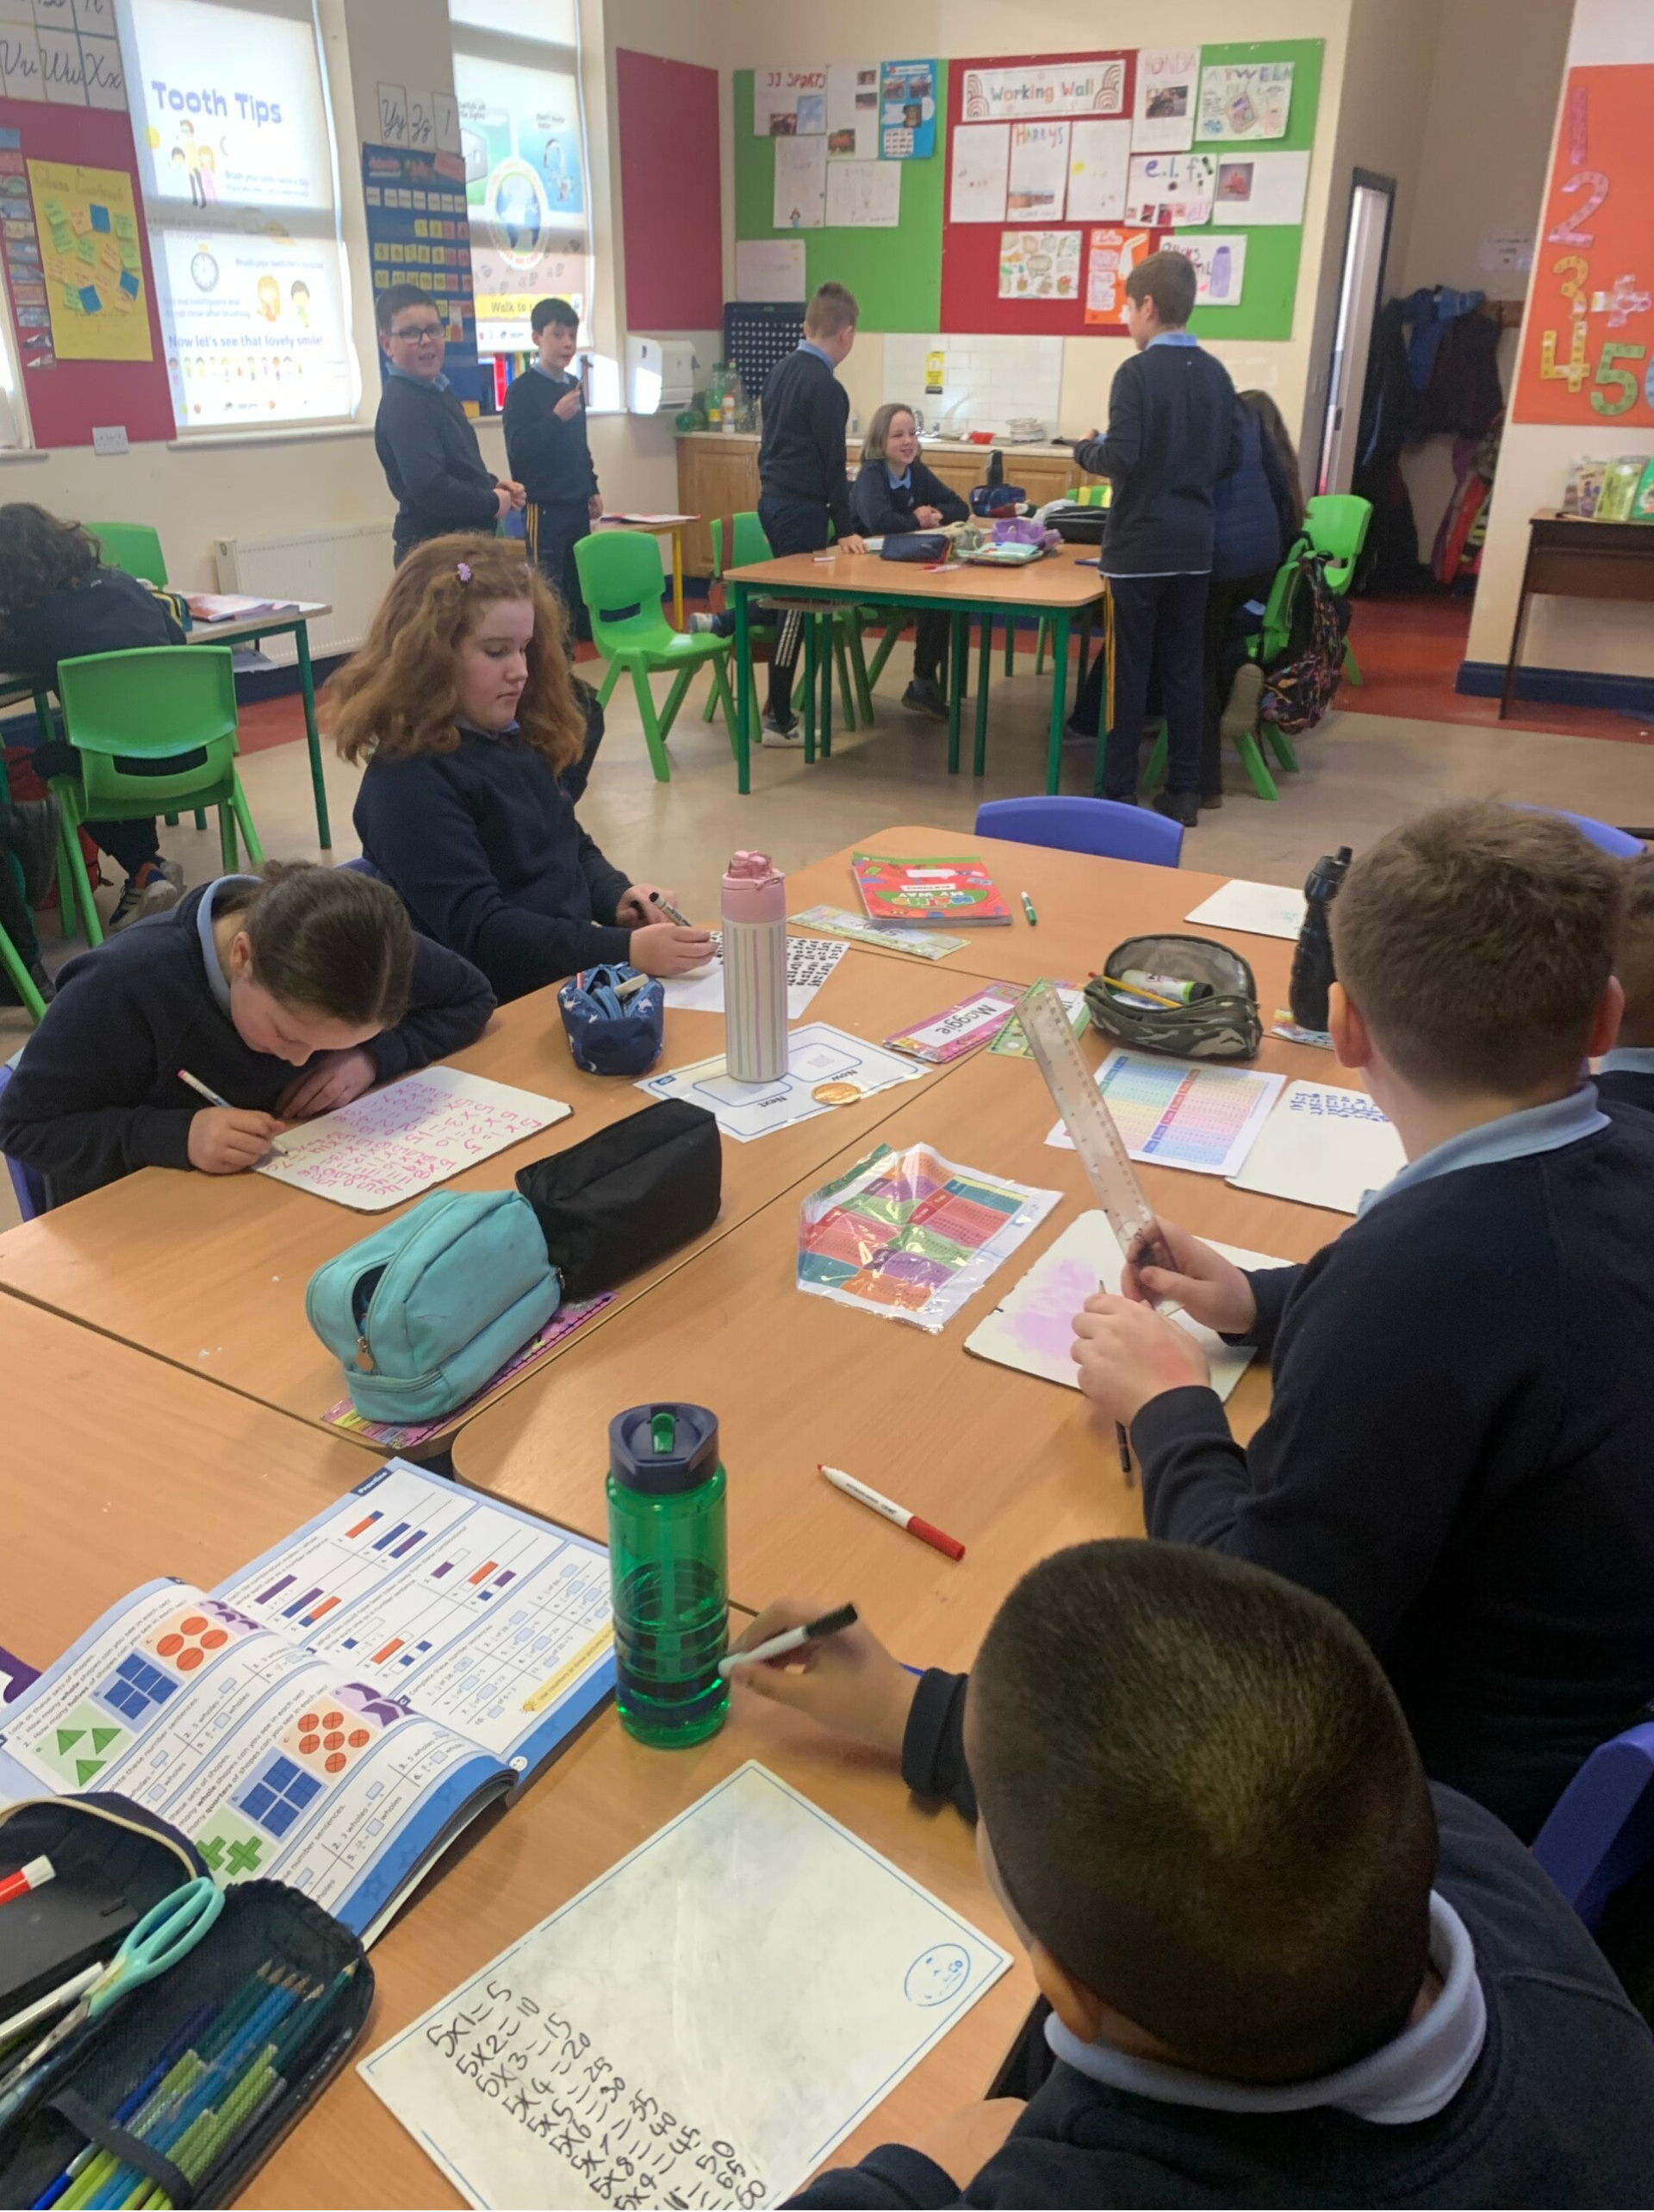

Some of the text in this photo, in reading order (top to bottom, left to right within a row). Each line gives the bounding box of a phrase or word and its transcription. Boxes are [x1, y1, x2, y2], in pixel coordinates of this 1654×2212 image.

[152, 80, 282, 128] Tooth Tips
[992, 78, 1094, 103] Working Wall
[1548, 86, 1608, 248] 1 2
[1553, 256, 1589, 321] 3
[491, 302, 514, 313] Walk
[169, 335, 193, 348] Now
[196, 334, 218, 348] let's
[221, 337, 238, 347] see
[240, 334, 262, 347] that
[265, 334, 294, 350] lovely
[1540, 321, 1645, 415] 4 5
[935, 1004, 997, 1037] Maggie
[830, 1069, 858, 1082] Now
[758, 1095, 787, 1107] Next
[357, 1469, 388, 1494] Practice
[25, 1717, 41, 1733] How
[40, 1700, 61, 1719] many
[59, 1680, 81, 1701] whole
[79, 1659, 102, 1682] shapes
[100, 1647, 114, 1660] can
[112, 1636, 126, 1649] you
[123, 1625, 136, 1637] see
[141, 1606, 159, 1622] each
[33, 1723, 49, 1739] How
[48, 1706, 69, 1725] many
[66, 1685, 90, 1706] halves
[94, 1655, 119, 1679] shapes
[116, 1644, 130, 1657] can
[128, 1633, 142, 1646] you
[140, 1623, 152, 1635] see
[159, 1604, 175, 1620] each
[32, 1695, 52, 1713] these
[51, 1682, 65, 1696] sets
[64, 1674, 73, 1683] of
[227, 1691, 250, 1715] wholes
[196, 1698, 220, 1723] wholes
[124, 1755, 146, 1775] these
[143, 1729, 168, 1756] number
[177, 1805, 198, 1826] many
[196, 1784, 217, 1807] whole
[215, 1760, 239, 1785] shapes
[235, 1747, 250, 1760] can
[248, 1734, 261, 1748] you
[259, 1722, 272, 1735] see
[270, 1714, 278, 1723] in
[276, 1699, 294, 1717] each
[185, 1812, 207, 1834] many
[204, 1782, 233, 1814] quarters
[230, 1773, 240, 1783] of
[237, 1748, 260, 1775] shapes
[258, 1736, 273, 1751] can
[270, 1724, 285, 1739] you
[281, 1712, 295, 1725] see
[300, 1692, 317, 1709] each
[162, 1761, 186, 1786] wholes
[167, 1799, 187, 1821] these
[186, 1785, 201, 1802] sets
[198, 1777, 208, 1787] of
[380, 1794, 402, 1821] wholes
[345, 1805, 369, 1834] wholes
[289, 1840, 315, 1870] number
